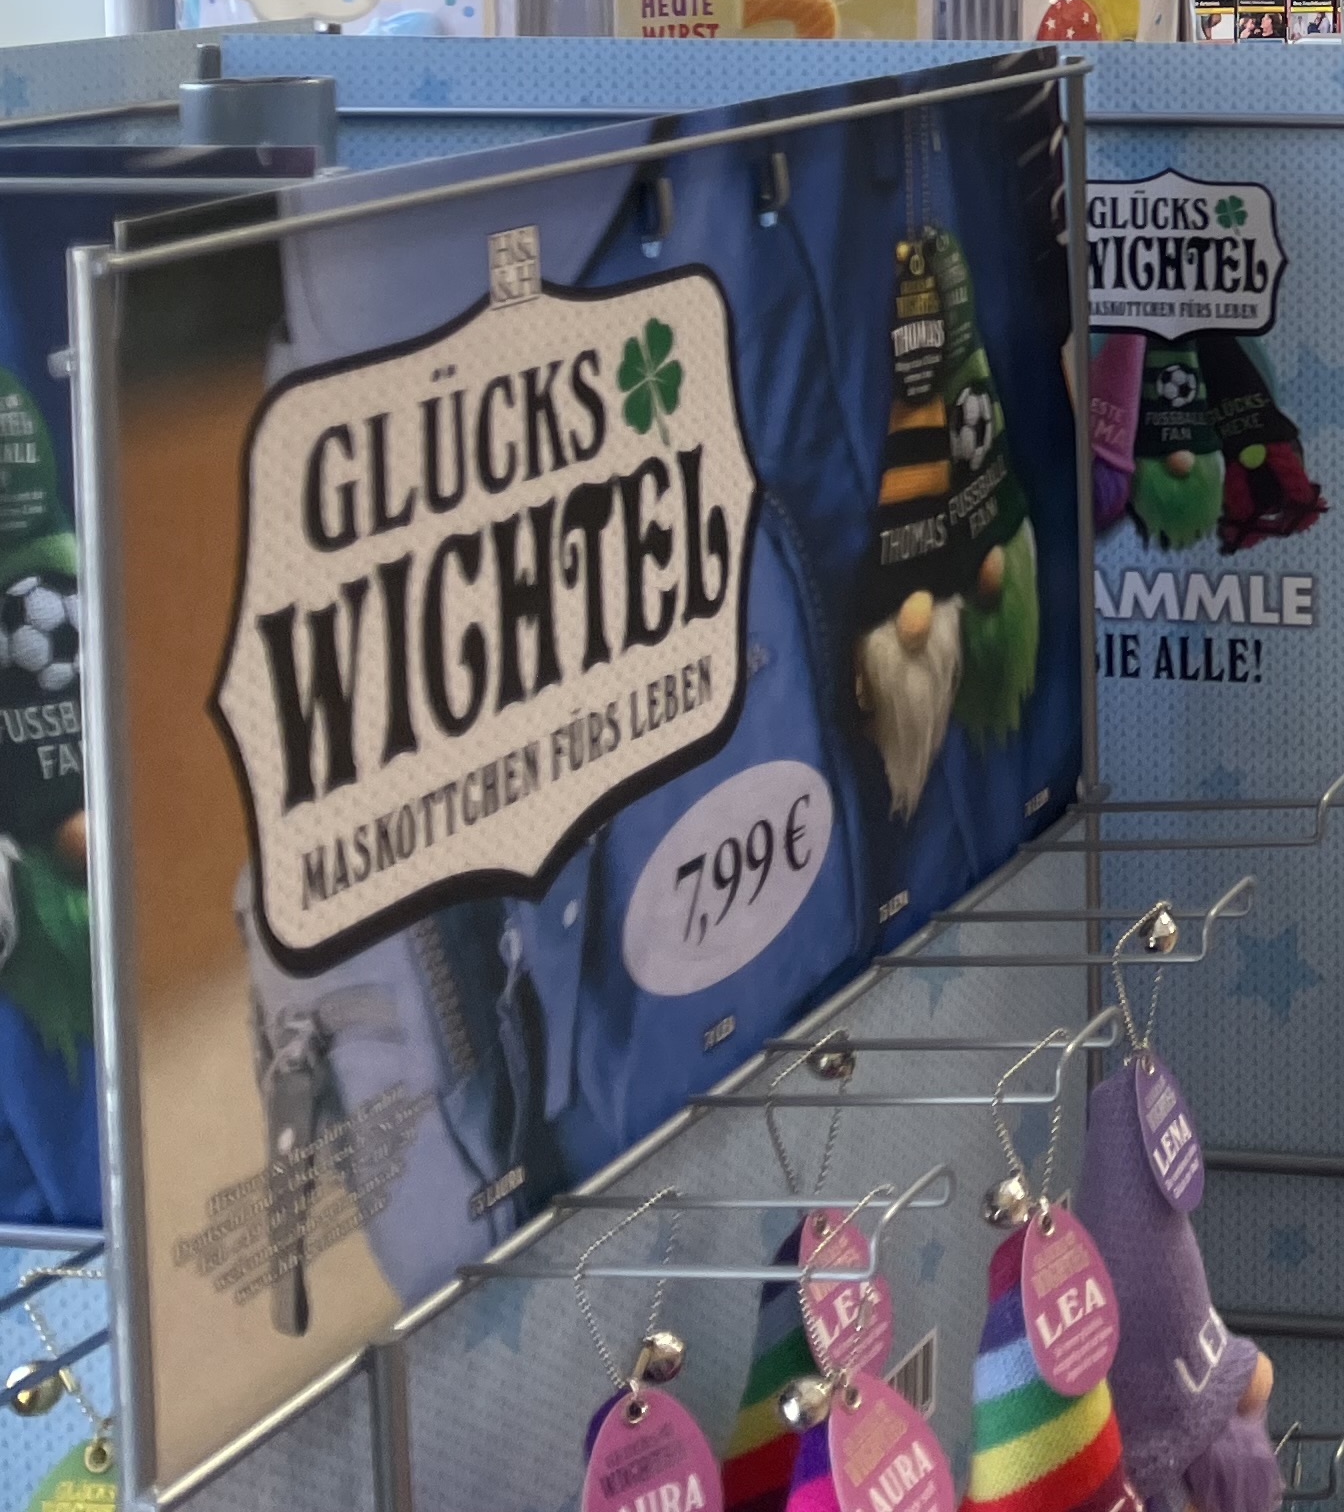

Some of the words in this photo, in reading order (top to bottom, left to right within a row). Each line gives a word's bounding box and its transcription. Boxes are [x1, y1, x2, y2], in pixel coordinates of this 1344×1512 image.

[1088, 190, 1210, 230] GLÜCKS
[1179, 298, 1212, 319] FÜRS
[1215, 301, 1258, 319] LEBEN
[302, 348, 609, 556] GLÜCKS
[880, 514, 947, 566] THOMAS
[256, 443, 730, 814] WICHTEL
[1153, 635, 1263, 683] ALLE!
[299, 749, 542, 912] MASKOTTCHEN
[550, 704, 621, 794] FÜRS
[630, 655, 713, 740] LEBEN
[672, 813, 776, 947] 7,99
[781, 791, 813, 872] €
[1152, 1112, 1193, 1177] LENA
[1036, 1277, 1108, 1349] LEA
